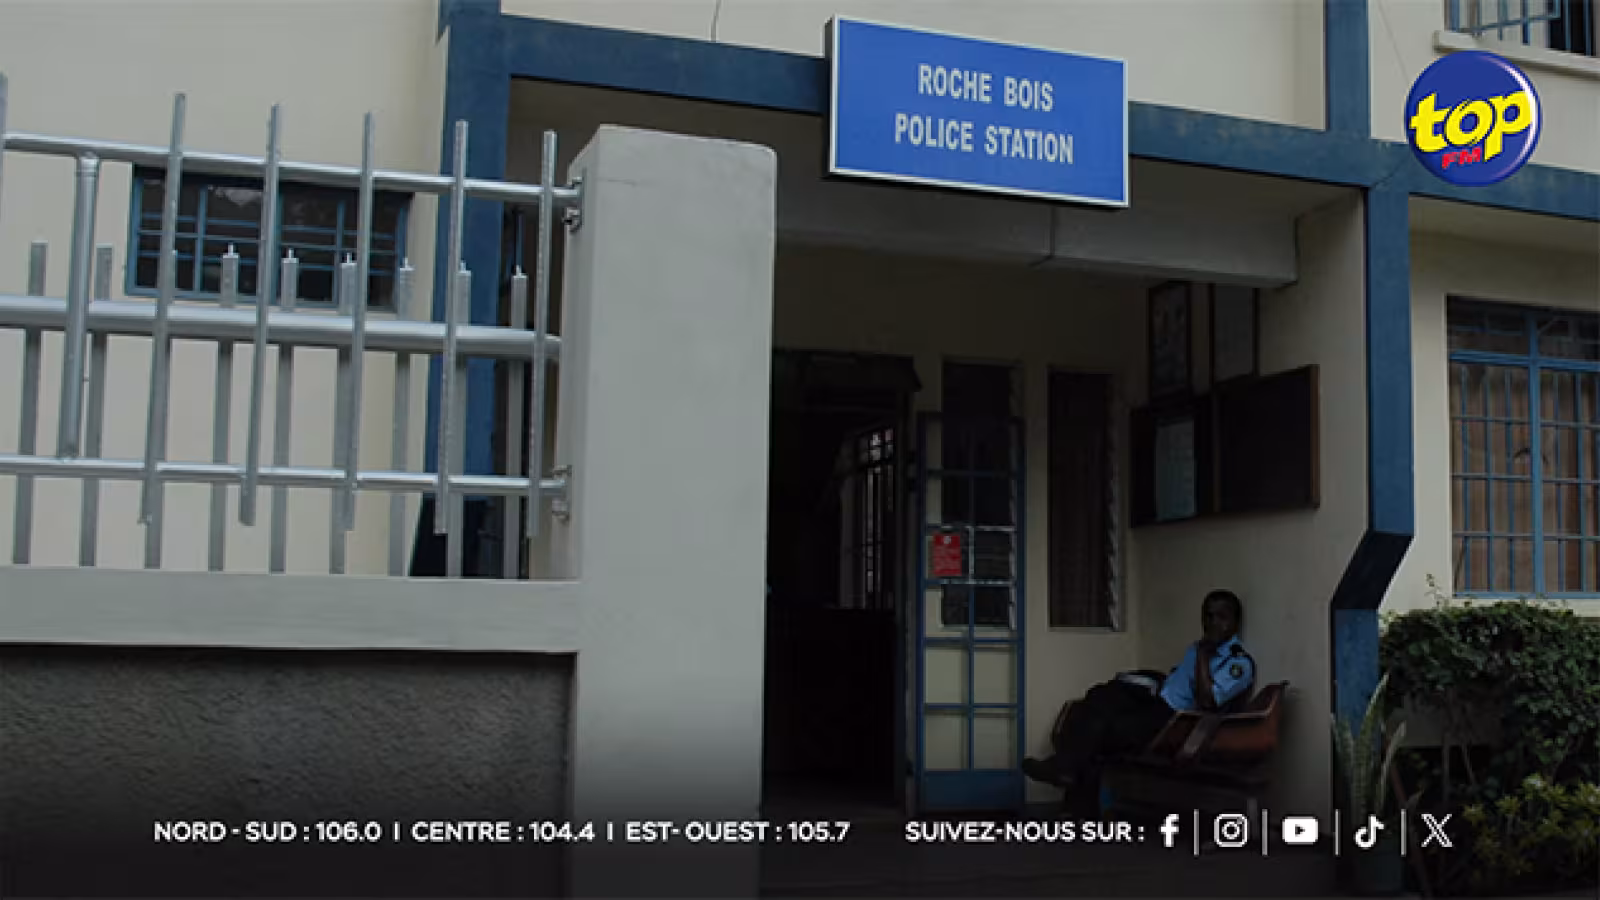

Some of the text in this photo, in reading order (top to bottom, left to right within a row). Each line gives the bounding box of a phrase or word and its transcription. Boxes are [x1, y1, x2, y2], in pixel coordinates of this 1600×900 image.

[918, 63, 1054, 112] ROCHE BOIS
[895, 113, 1074, 164] POLICE STATION
